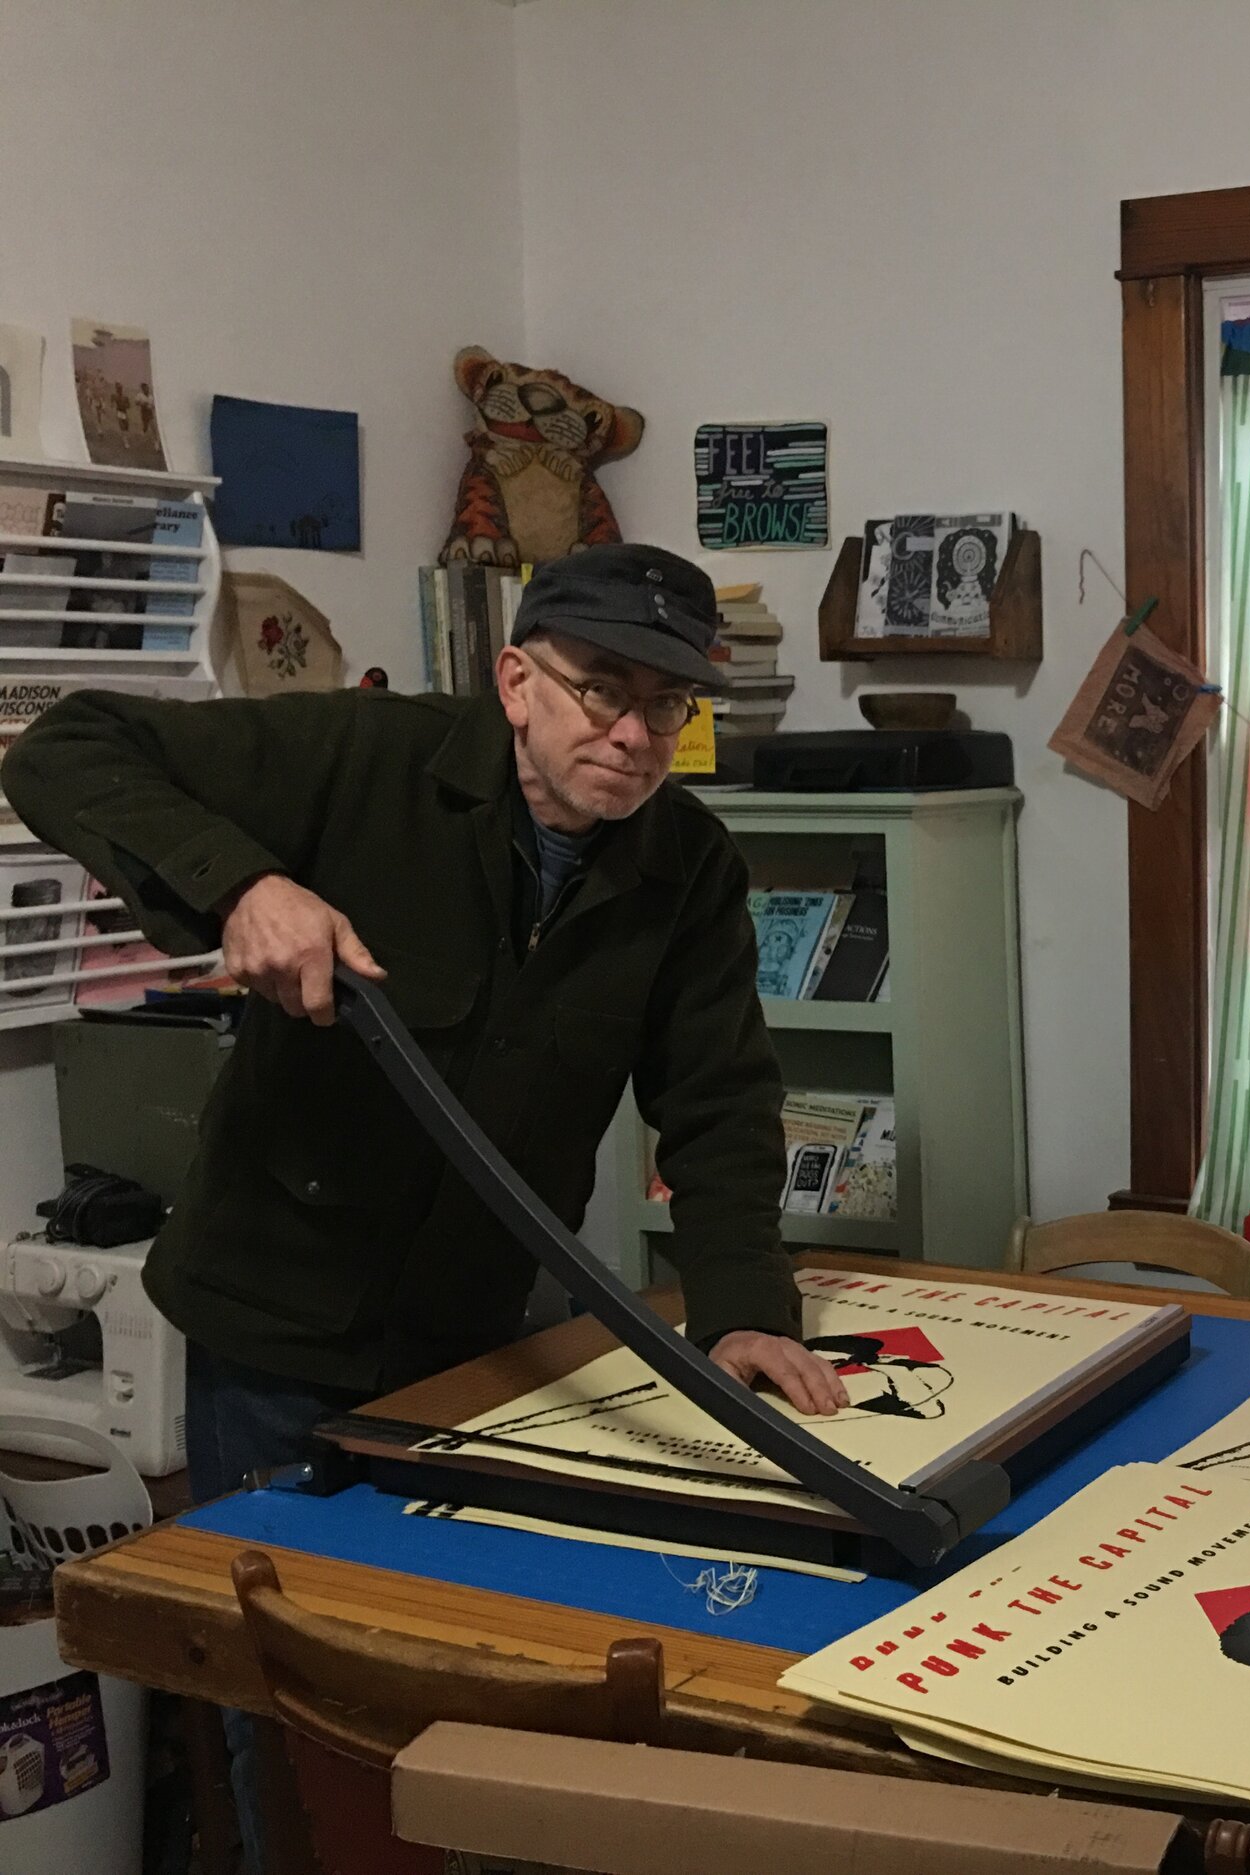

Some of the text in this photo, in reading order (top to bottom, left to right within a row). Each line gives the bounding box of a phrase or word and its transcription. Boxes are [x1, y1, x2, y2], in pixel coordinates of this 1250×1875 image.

[707, 433, 774, 475] FEEL
[712, 479, 783, 508] free to
[722, 502, 815, 542] BROWSE
[1097, 663, 1142, 735] MORE
[797, 1275, 1131, 1321] PUNK THE CAPITAL
[801, 1292, 880, 1311] BUILDING
[904, 1310, 964, 1324] SOUND
[971, 1322, 1072, 1342] MOVEMENT
[691, 1439, 737, 1449] PUNK
[895, 1484, 1213, 1695] PUNK THE CAPITAL
[997, 1621, 1099, 1686] BUILDING
[1104, 1610, 1121, 1620] A
[1123, 1568, 1185, 1608] SOUND
